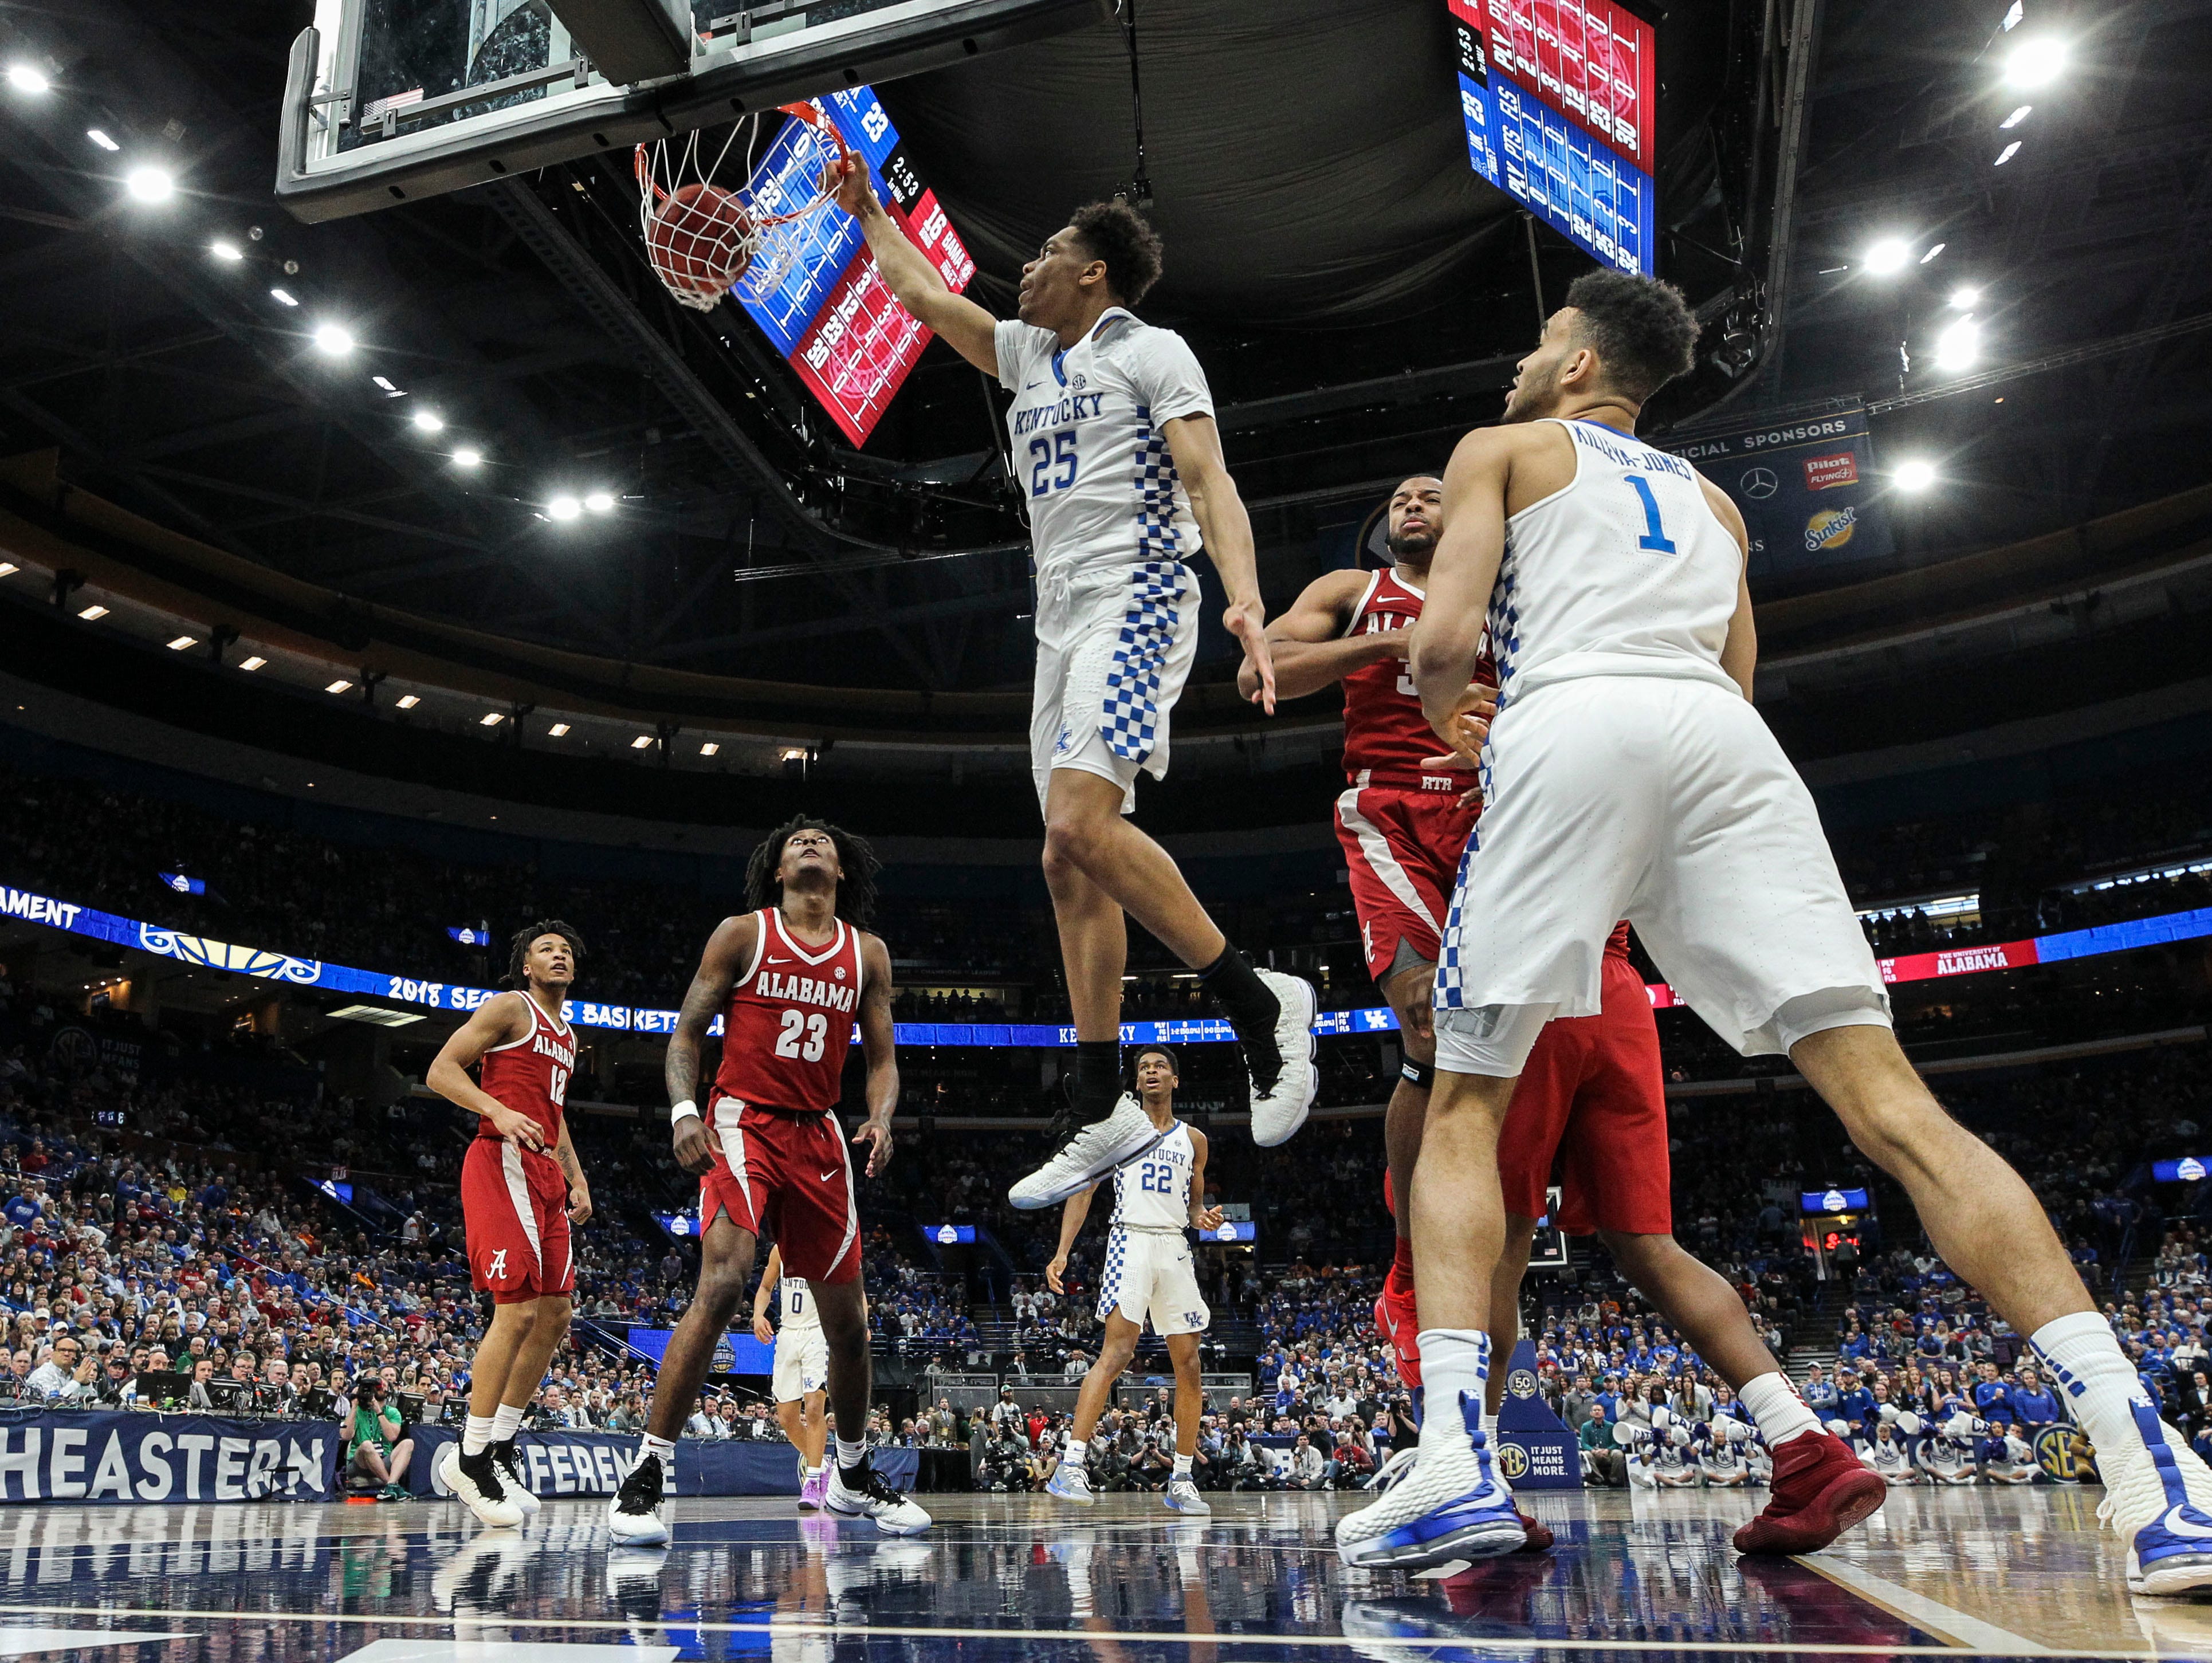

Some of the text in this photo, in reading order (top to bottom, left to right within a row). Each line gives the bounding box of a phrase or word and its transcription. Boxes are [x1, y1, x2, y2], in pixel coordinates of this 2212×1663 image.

[1512, 10, 1533, 32] 8
[1457, 27, 1475, 72] 2:53
[1491, 27, 1514, 72] PLY
[1537, 27, 1558, 48] 3
[1562, 44, 1583, 63] 4
[1516, 56, 1537, 77] 2
[1541, 72, 1561, 93] 3
[1586, 13, 1611, 134] 23 0 0
[1565, 84, 1586, 116] 12
[1613, 33, 1637, 151] 30 0 1
[861, 102, 889, 143] 23
[1461, 90, 1485, 127] 23
[793, 132, 810, 158] 0
[1468, 129, 1484, 152] UK
[1498, 85, 1527, 199] PLY PTS FLS
[1522, 111, 1548, 206] 0 2 1
[1545, 125, 1570, 222] 1 0 0
[893, 157, 919, 196] 2:53
[1568, 144, 1593, 243] 22 7 1
[1592, 159, 1615, 260] 25 2 0
[827, 230, 843, 253] 0
[923, 203, 966, 270] 16 BAMA
[1616, 178, 1639, 276] 32 3 1
[811, 254, 827, 278] 1
[796, 278, 812, 302] 0
[780, 302, 796, 327] 1
[855, 270, 911, 353] 3 3 0
[837, 290, 897, 376] 12 4 1
[822, 314, 883, 398] 23 0 0
[807, 337, 868, 420] 30 0 1
[1073, 376, 1086, 388] SEC
[1014, 392, 1103, 435] KENTUCKY
[1744, 419, 1846, 448] SPONSORS
[1030, 430, 1078, 497] 25
[1623, 474, 1677, 555] 1
[1805, 506, 1857, 551] Sunkist
[1421, 776, 1452, 791] RTR
[1881, 958, 1895, 968] PLY
[1937, 951, 2009, 975] ALABAMA
[1952, 948, 1992, 958] UNIVERSITY
[388, 976, 443, 1008] 2018
[756, 970, 855, 1013] ALABAMA
[1884, 974, 1897, 982] FLS
[1364, 1009, 1388, 1029] UK
[775, 1009, 828, 1063] 23
[549, 1064, 568, 1101] 12
[1142, 1162, 1172, 1194] 22
[485, 1248, 508, 1280] A
[792, 1292, 803, 1314] 0
[1183, 1311, 1204, 1329] UK
[0, 1427, 325, 1500] HEASTERN
[1530, 1446, 1540, 1454] IT
[1540, 1446, 1563, 1454] JUST
[1531, 1456, 1564, 1465] MEANS
[2040, 1432, 2079, 1479] SE
[1533, 1465, 1568, 1476] MORE.
